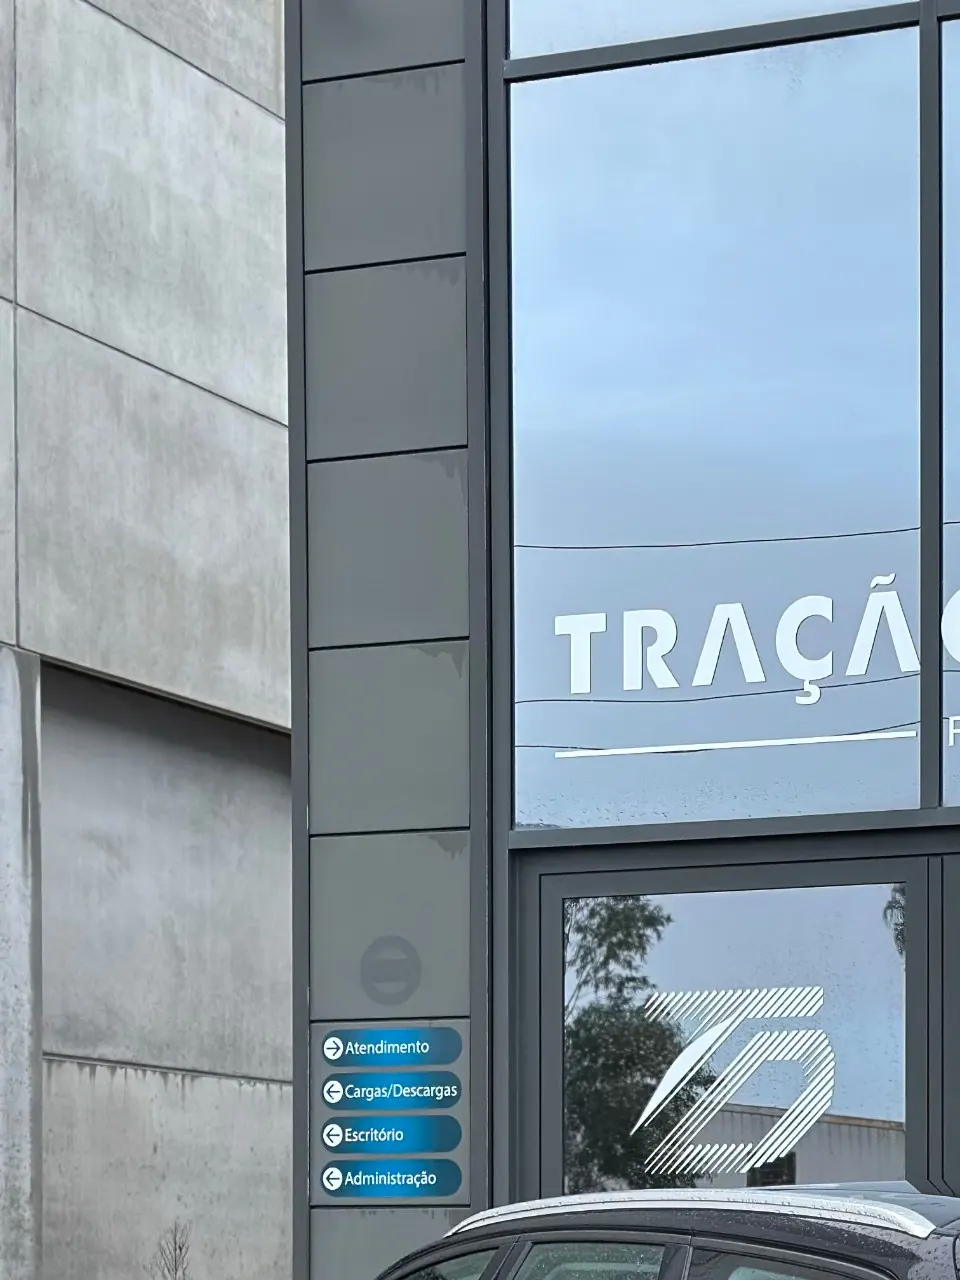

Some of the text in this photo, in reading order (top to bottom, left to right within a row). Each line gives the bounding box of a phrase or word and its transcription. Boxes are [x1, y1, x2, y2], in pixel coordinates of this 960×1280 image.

[345, 1041, 430, 1055] Atendimento
[345, 1083, 458, 1102] Cargas/Descargas
[344, 1127, 404, 1142] Escritório
[344, 1171, 437, 1189] Administração
